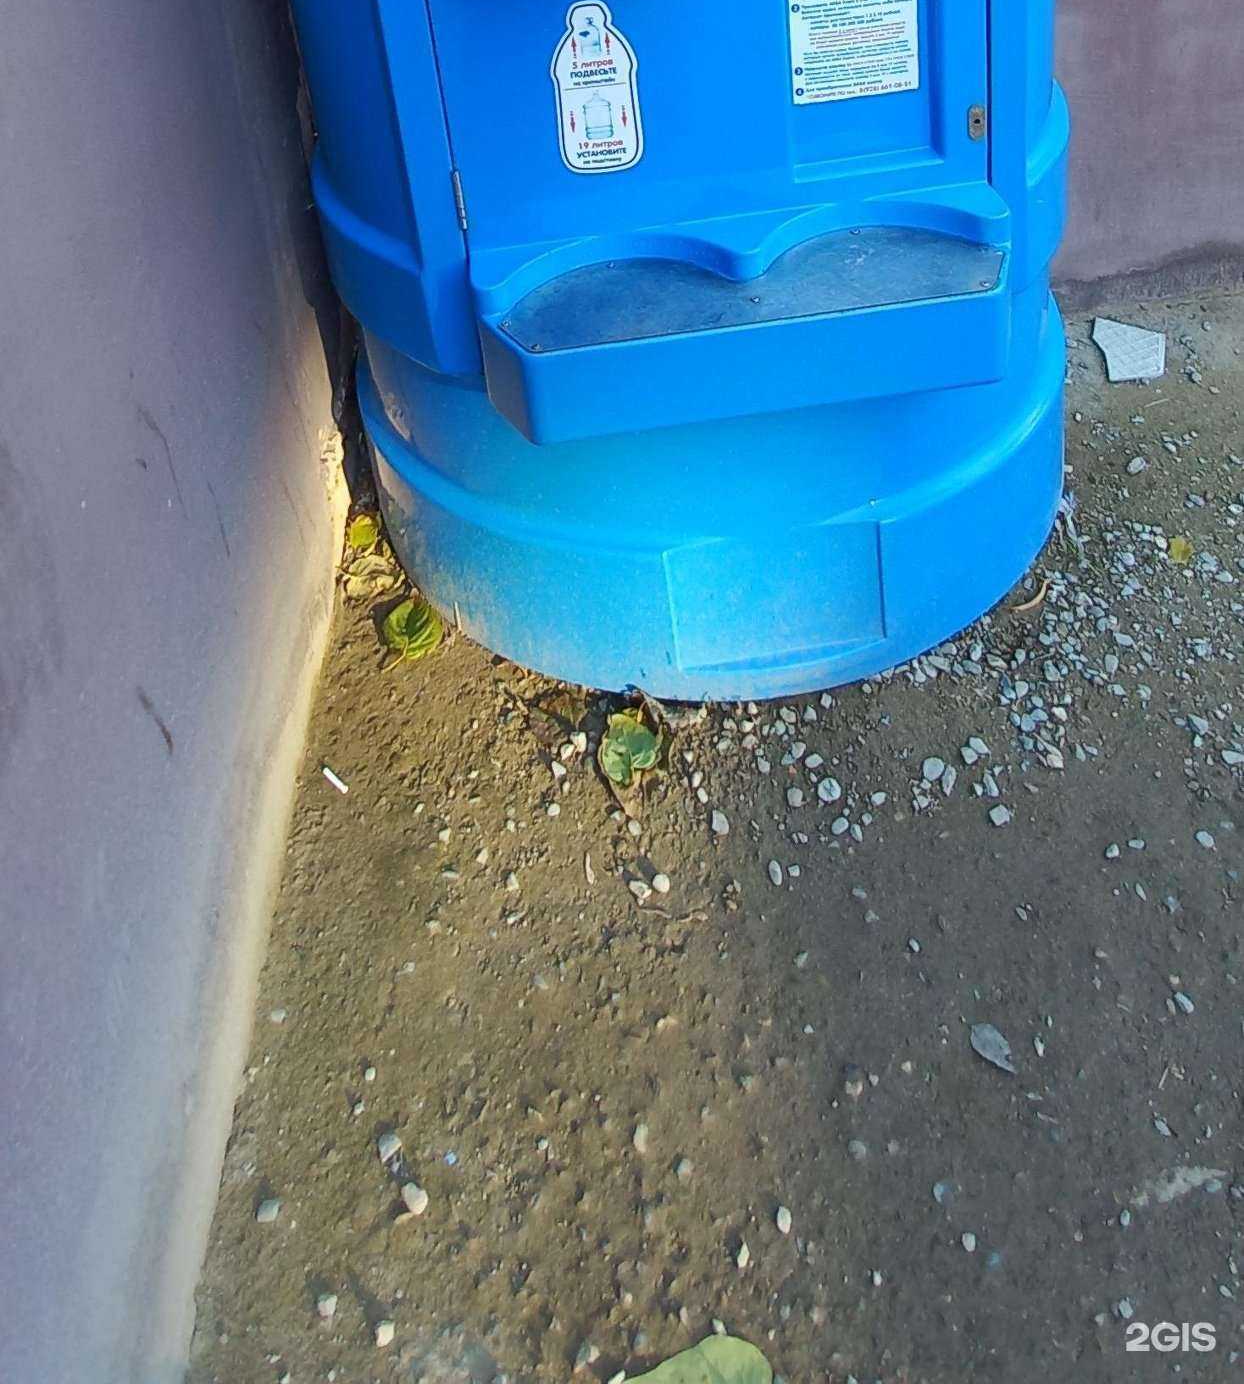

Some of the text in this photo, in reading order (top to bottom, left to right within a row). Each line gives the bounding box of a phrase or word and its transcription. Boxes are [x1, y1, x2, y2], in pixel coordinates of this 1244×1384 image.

[572, 62, 578, 70] 5
[570, 67, 617, 78] ПОДВЕСЬТЕ
[577, 147, 627, 159] УСТАНОВИТЕ
